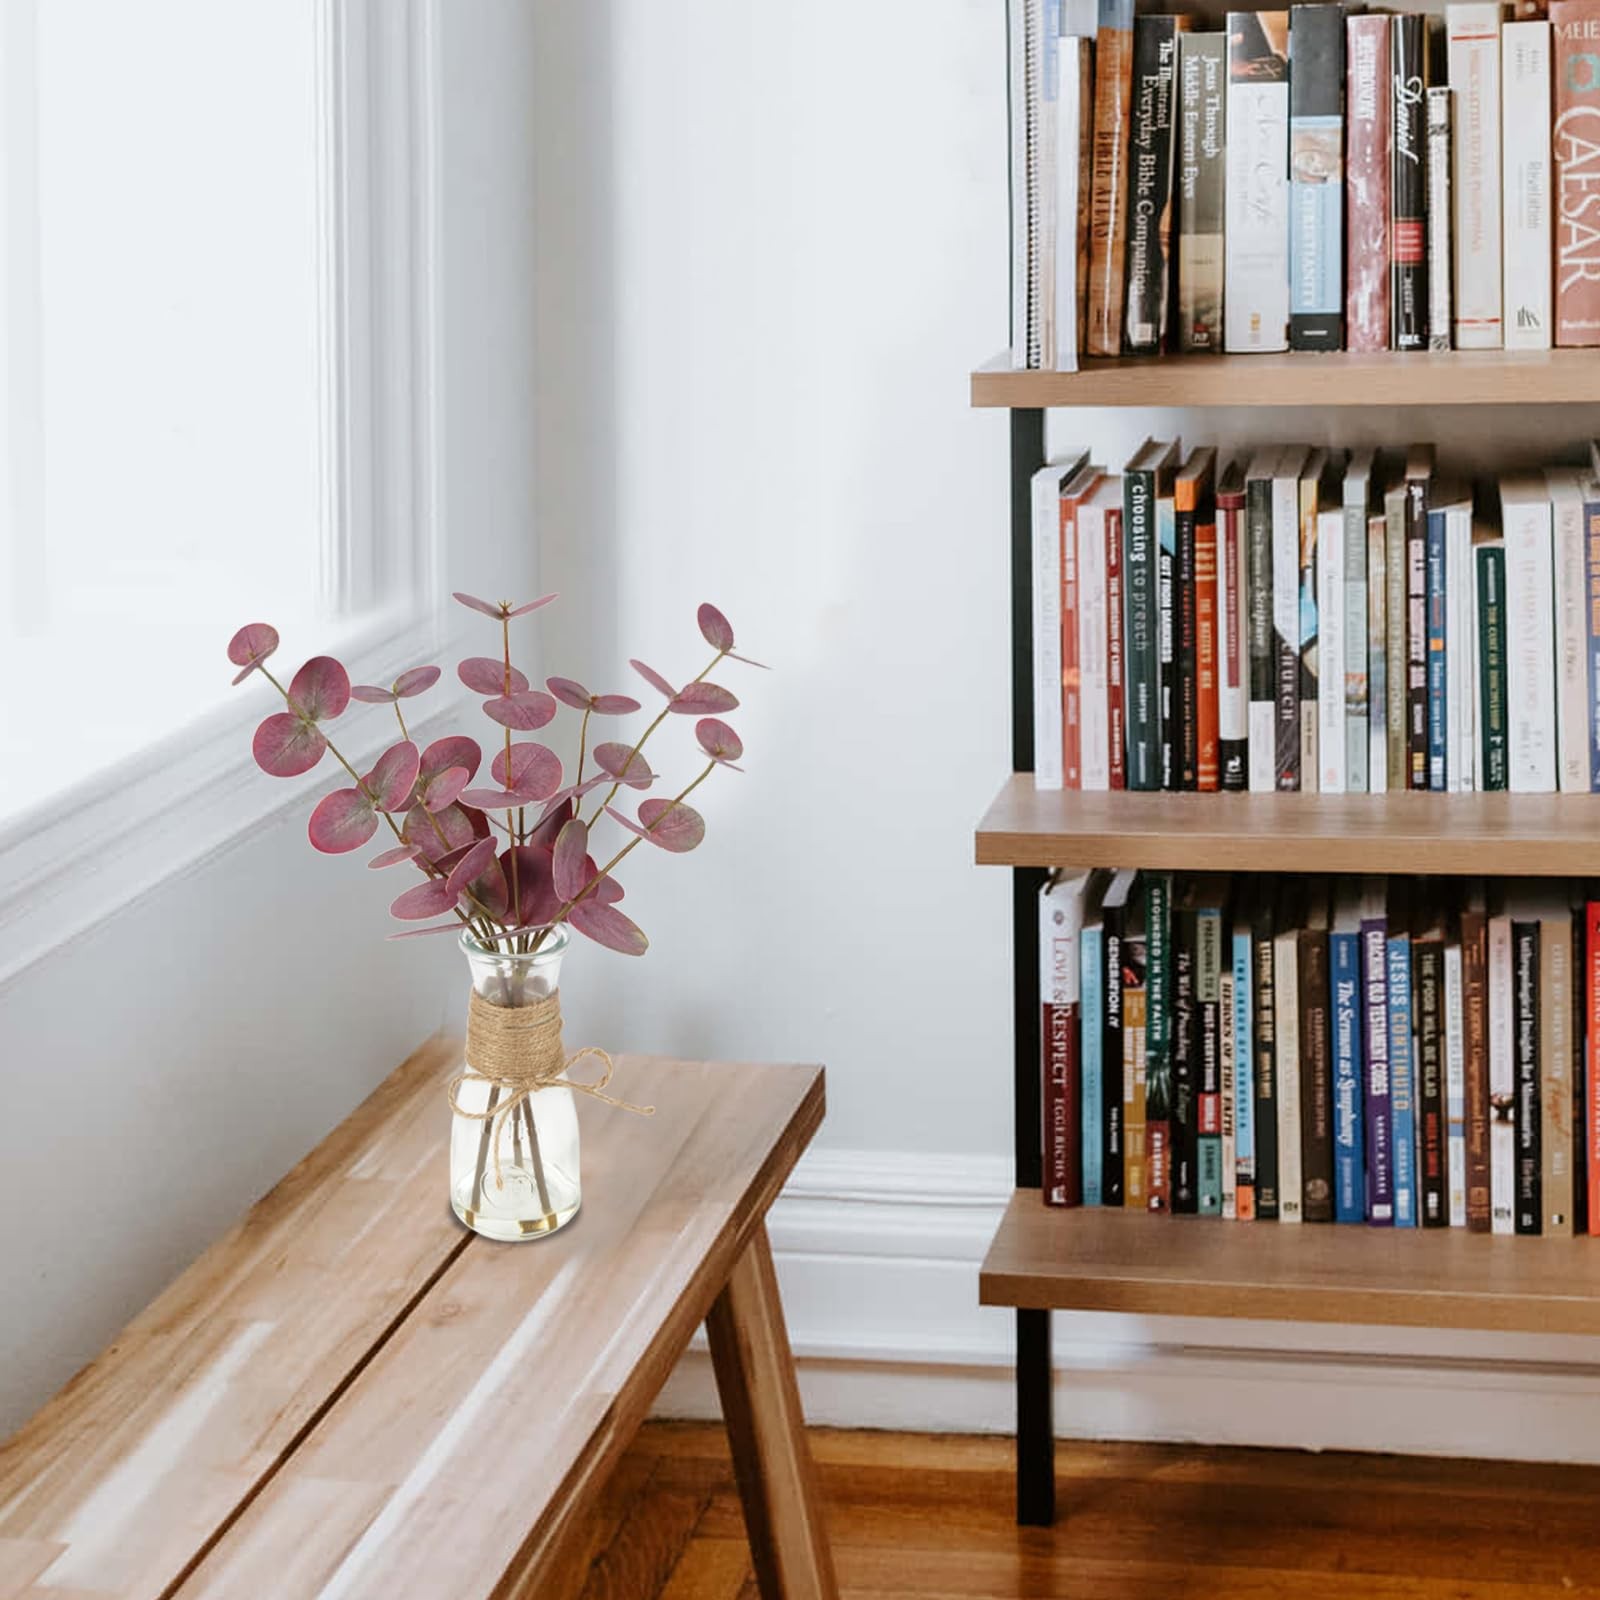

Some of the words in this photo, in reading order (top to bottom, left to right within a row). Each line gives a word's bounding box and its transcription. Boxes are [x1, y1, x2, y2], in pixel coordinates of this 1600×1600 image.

[1158, 39, 1173, 65] The
[1201, 55, 1221, 92] Jesus
[1157, 66, 1172, 129] Illustrated
[1184, 55, 1201, 108] Middle
[1136, 74, 1159, 149] Everyday
[1201, 95, 1221, 159] Through
[1396, 74, 1423, 165] Daniel
[1184, 111, 1200, 163] Eastern
[1138, 154, 1157, 197] Bible
[1181, 166, 1199, 201] Eyes
[1554, 104, 1600, 295] CAESAR
[1131, 200, 1155, 297] Companion
[1130, 485, 1151, 562] choosing
[1134, 567, 1147, 587] to
[1132, 592, 1150, 650] preach
[1251, 589, 1269, 648] Scripture
[1281, 642, 1295, 721] CHURCH
[1150, 888, 1163, 957] GROUNDED
[1052, 936, 1073, 984] LOVE
[1107, 935, 1121, 1013] GENERATION
[1152, 960, 1163, 974] IN
[1178, 953, 1191, 972] The
[1366, 931, 1386, 982] CRACKING
[1390, 950, 1409, 1006] JESUS
[1422, 954, 1435, 976] THE
[1518, 937, 1534, 1019] Anthropological
[1152, 978, 1163, 1001] THE
[1203, 976, 1214, 990] TO
[1337, 979, 1355, 1006] The
[1367, 982, 1387, 1004] OLD
[1423, 978, 1437, 1012] POOR
[1152, 1004, 1163, 1041] FAITH
[1223, 983, 1234, 1038] HEROES
[1338, 1007, 1354, 1058] Sermon
[1368, 1004, 1388, 1061] TESTAMENT
[1423, 1015, 1437, 1042] WILL
[1051, 1004, 1072, 1086] RESPECT
[1175, 1011, 1191, 1061] Preaching
[1203, 1003, 1216, 1091] POST-EVERYTHING
[1223, 1042, 1234, 1059] OF
[1423, 1046, 1438, 1063] BE
[1519, 1020, 1534, 1063] Insights
[1224, 1064, 1235, 1091] THE
[1339, 1059, 1352, 1076] as
[1370, 1062, 1389, 1096] CODES
[1424, 1065, 1438, 1098] GLAD
[1521, 1064, 1534, 1081] for
[1054, 1097, 1067, 1179] EGGERICHS
[1223, 1096, 1235, 1137] FAITH
[1336, 1077, 1357, 1149] Symphony
[1521, 1081, 1535, 1149] Missionaries
